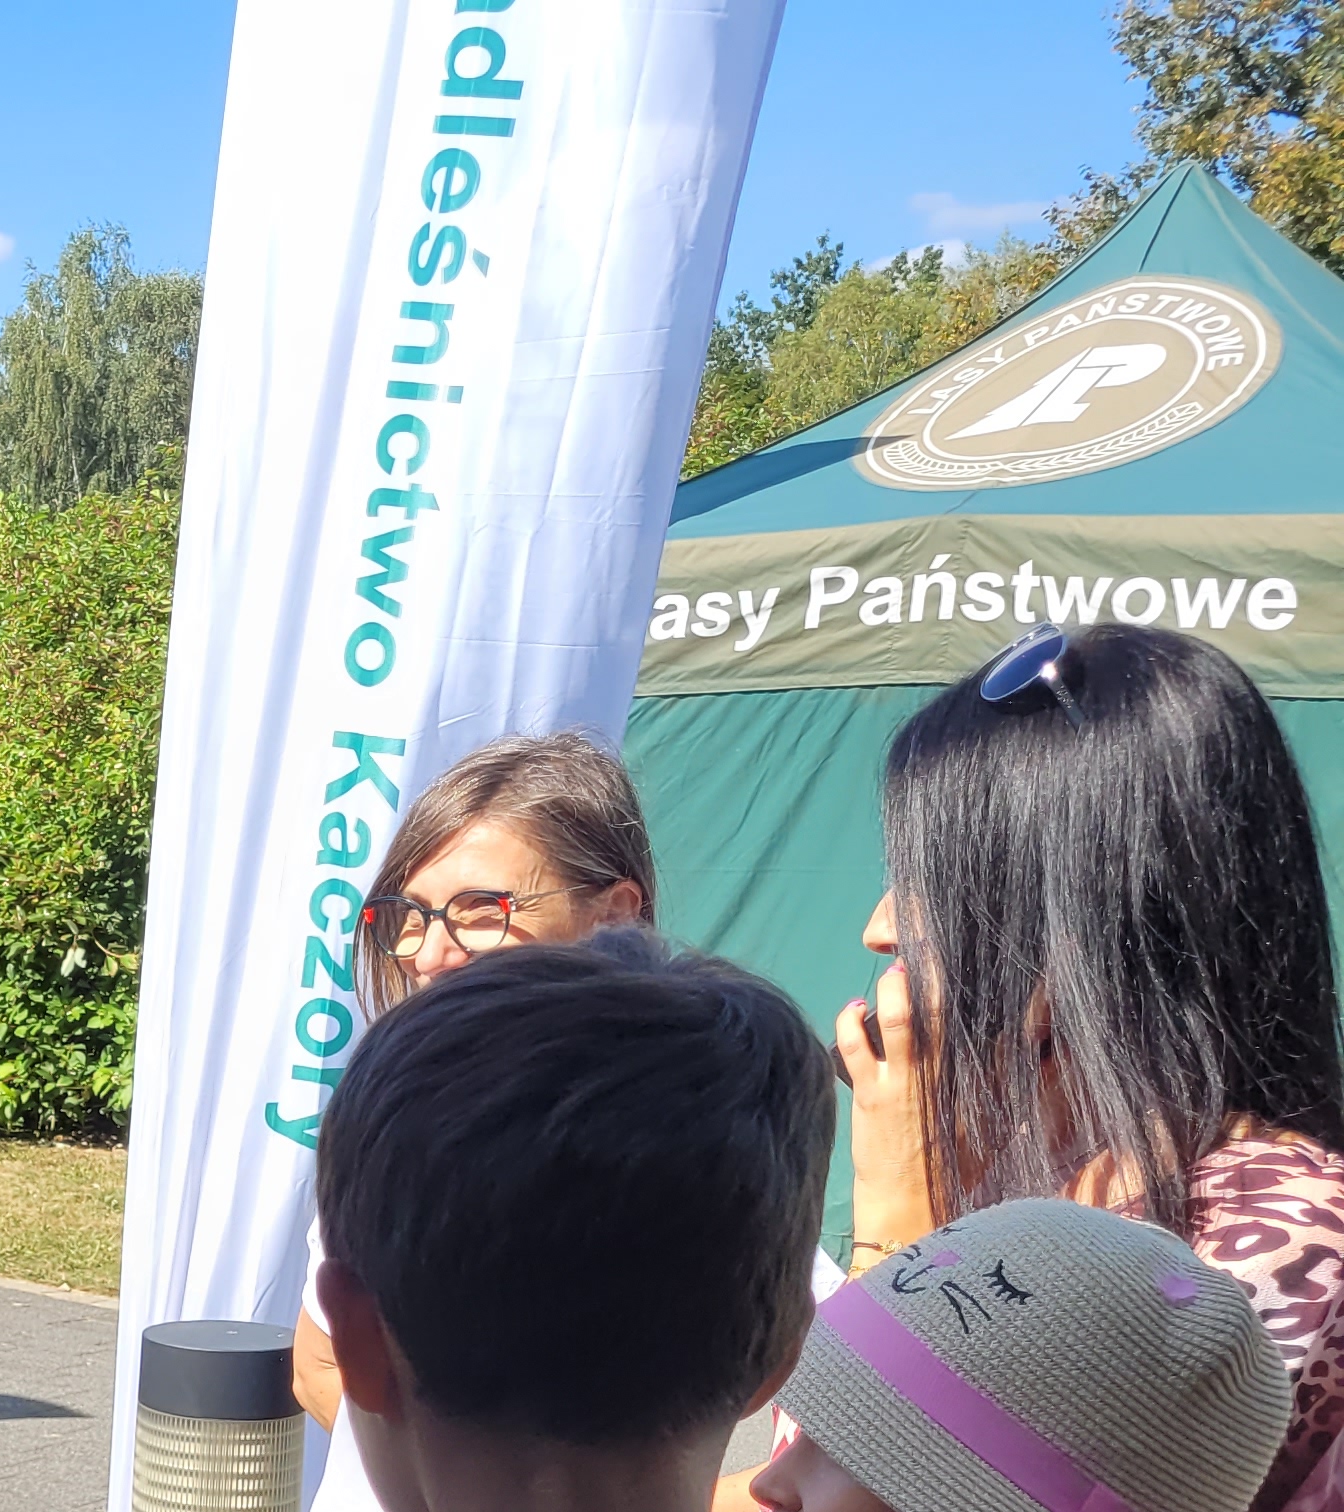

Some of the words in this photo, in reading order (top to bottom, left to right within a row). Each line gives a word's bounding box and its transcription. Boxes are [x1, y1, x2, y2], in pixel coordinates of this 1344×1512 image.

[343, 0, 525, 687] dleśnictwo
[906, 345, 1007, 416] LASY
[1023, 293, 1248, 372] PAŃSTWOWE
[648, 587, 781, 652] asy
[804, 553, 1300, 632] Państwowe
[265, 731, 406, 1151] Kaczory
